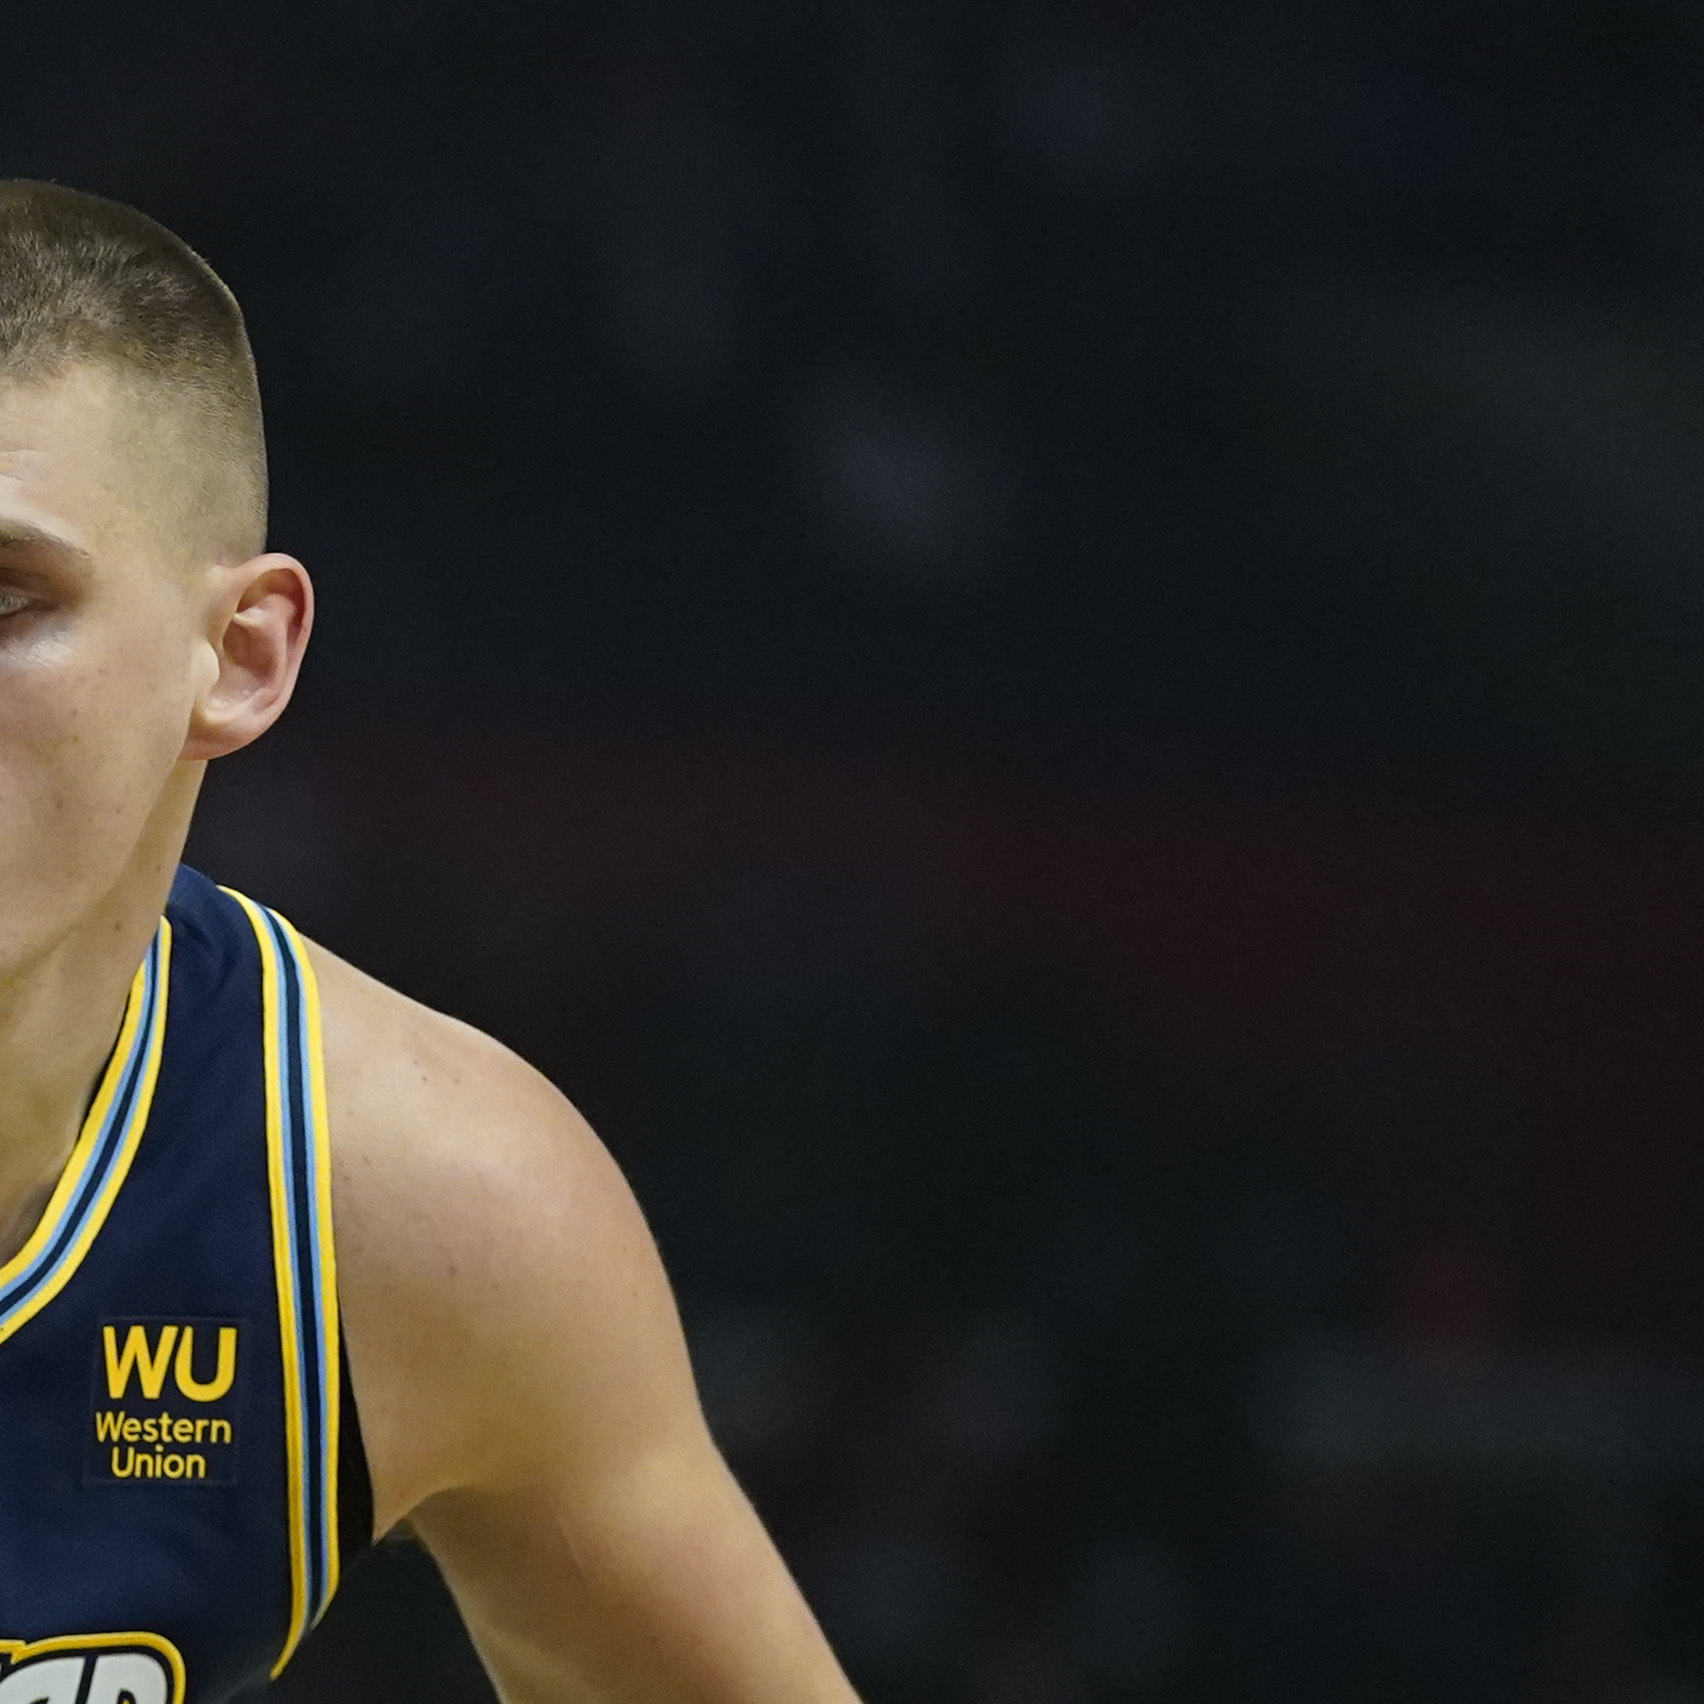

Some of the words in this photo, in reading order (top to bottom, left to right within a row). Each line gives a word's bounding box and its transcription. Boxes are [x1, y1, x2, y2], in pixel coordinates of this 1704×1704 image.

[103, 1325, 237, 1402] WU
[96, 1411, 232, 1444] Western
[111, 1444, 206, 1478] Union
